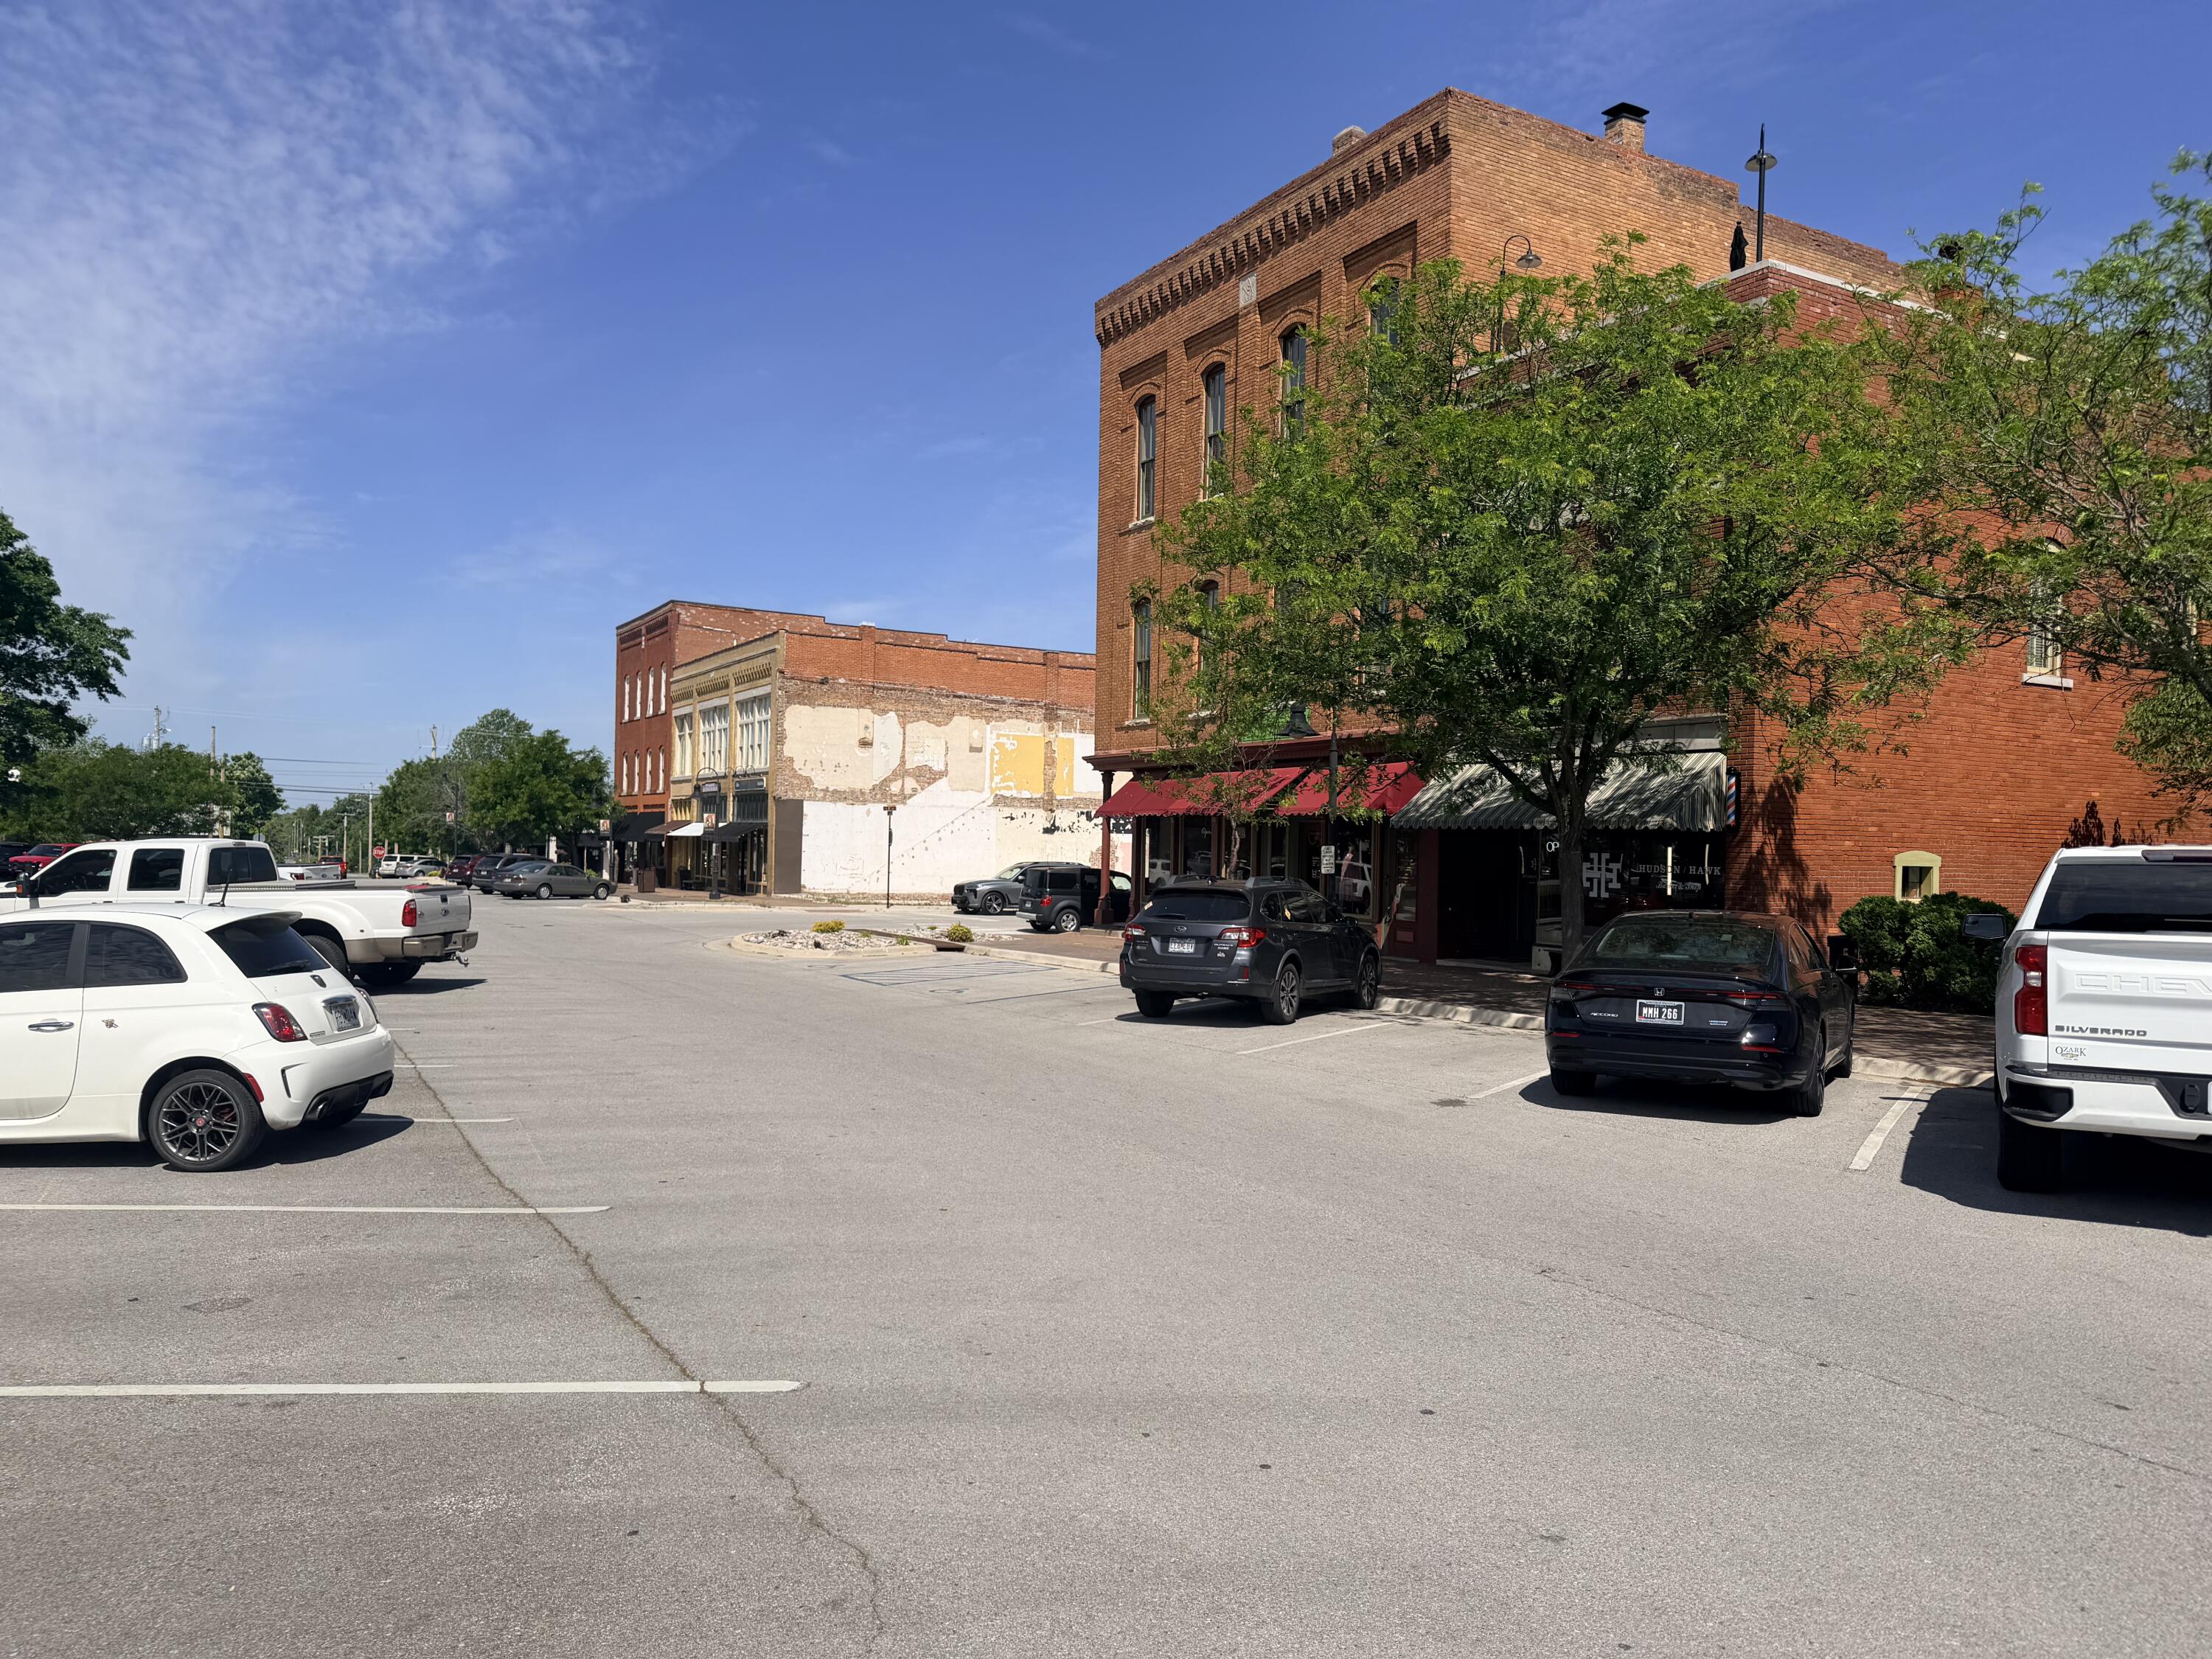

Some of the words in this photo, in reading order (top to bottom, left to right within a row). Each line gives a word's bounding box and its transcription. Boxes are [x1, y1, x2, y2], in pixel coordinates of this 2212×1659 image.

[1546, 841, 1559, 852] OP
[1639, 864, 1680, 874] HUDSON
[1688, 866, 1721, 875] HAWK
[1642, 1006, 1659, 1018] MMH
[1661, 1008, 1678, 1019] 266
[2055, 1025, 2147, 1037] SILVERADO
[2055, 1046, 2087, 1056] OZARK
